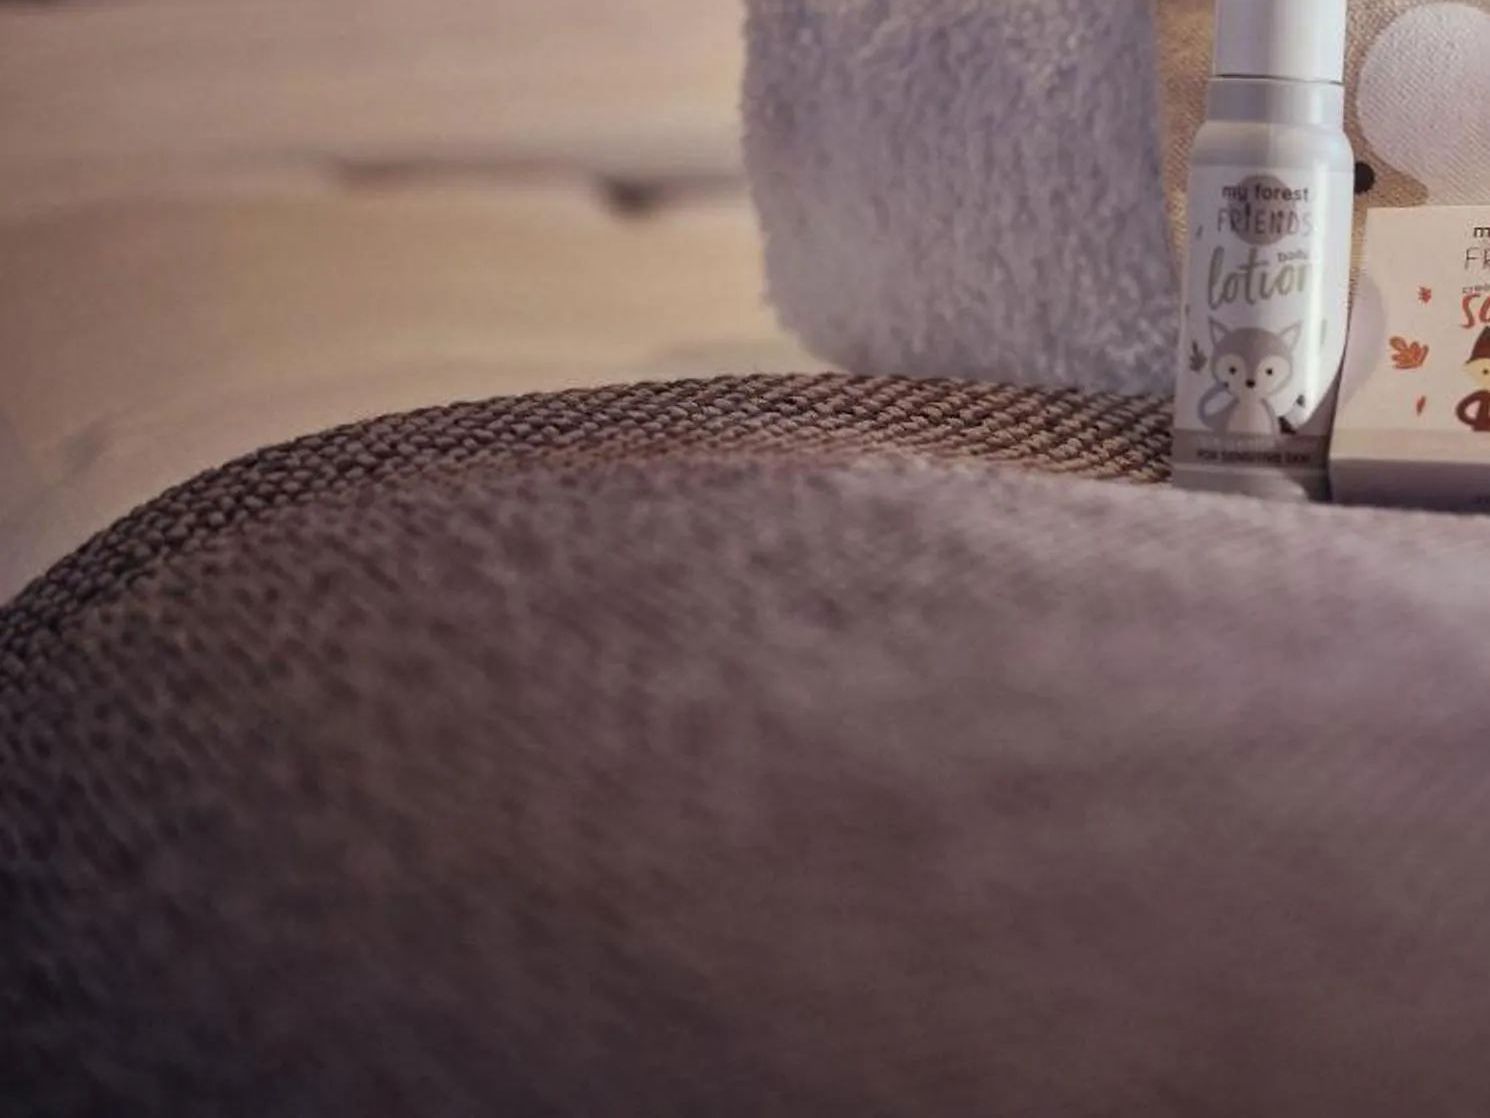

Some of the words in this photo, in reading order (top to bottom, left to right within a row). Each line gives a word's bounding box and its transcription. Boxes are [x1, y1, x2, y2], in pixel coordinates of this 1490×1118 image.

[1222, 186, 1248, 201] my
[1255, 183, 1309, 201] forest
[1218, 202, 1314, 236] FRIENDS
